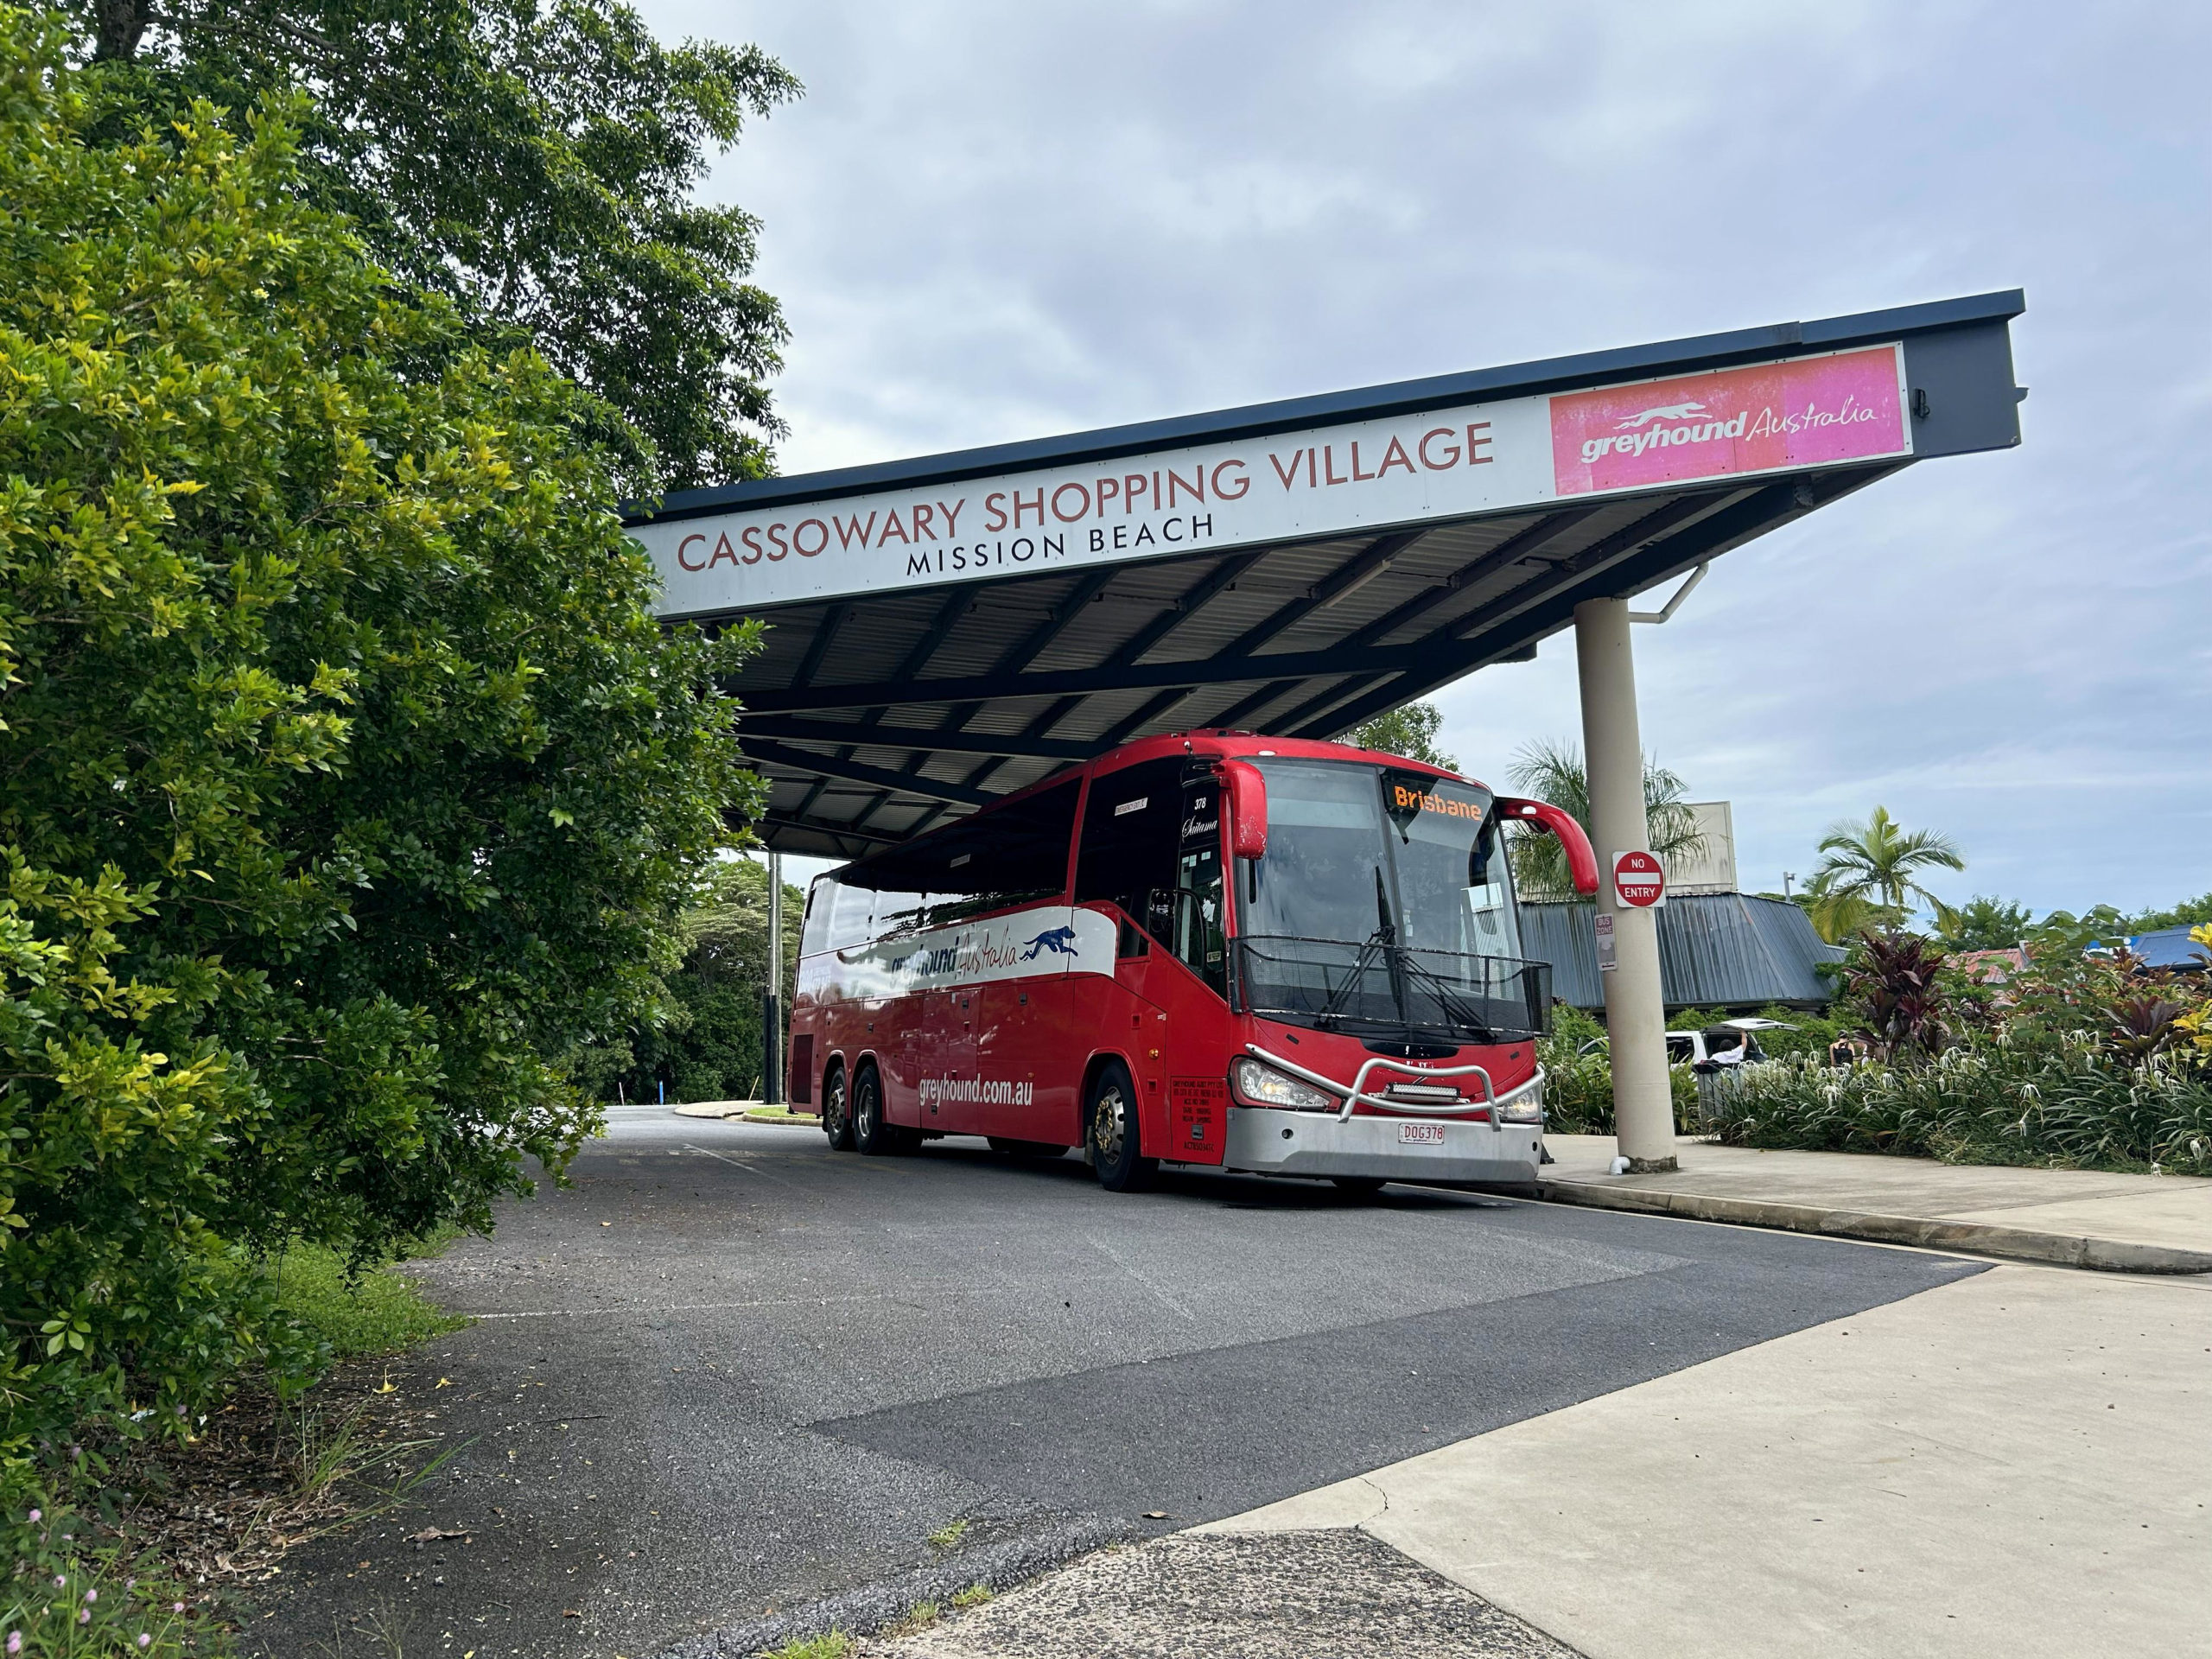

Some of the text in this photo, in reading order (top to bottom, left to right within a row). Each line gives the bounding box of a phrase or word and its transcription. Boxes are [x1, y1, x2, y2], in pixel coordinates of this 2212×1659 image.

[1580, 394, 1878, 464] greyhound Australia
[678, 422, 1493, 571] CASSOWARY SHOPPING VILLAGE
[907, 513, 1212, 576] MISSION BEACH
[1194, 797, 1206, 810] 378
[1394, 785, 1483, 822] Brisbane
[1182, 815, 1217, 843] Saitama
[1630, 858, 1645, 868] NO
[1624, 887, 1656, 898] ENTRY
[1597, 925, 1612, 934] ZONE
[955, 922, 1017, 980] Australia
[919, 1072, 1033, 1107] greyhound.com.au
[1404, 1125, 1443, 1140] DOG378
